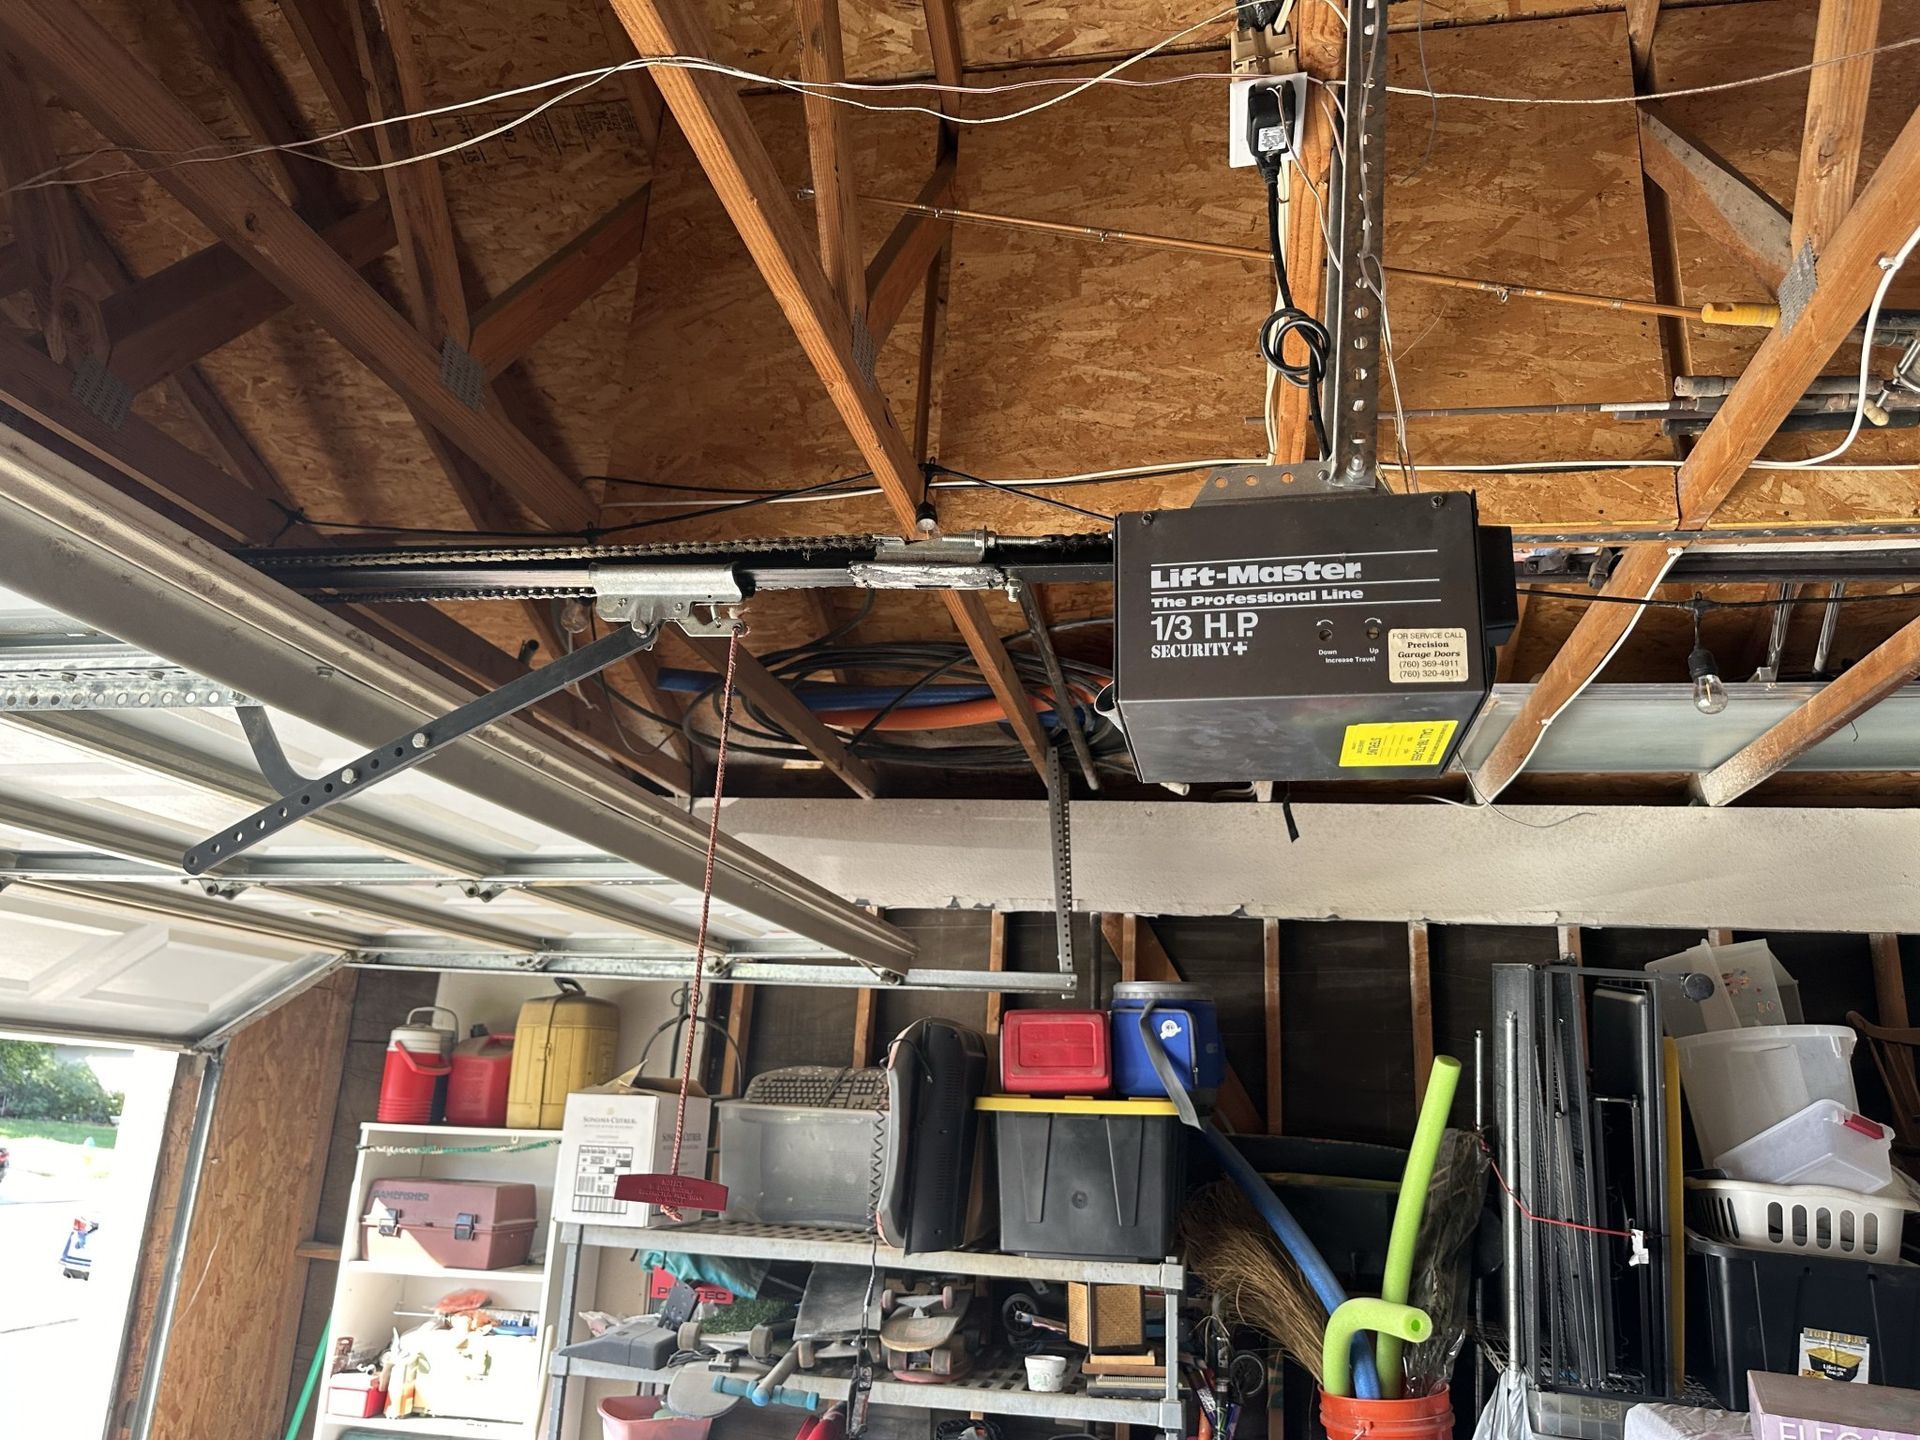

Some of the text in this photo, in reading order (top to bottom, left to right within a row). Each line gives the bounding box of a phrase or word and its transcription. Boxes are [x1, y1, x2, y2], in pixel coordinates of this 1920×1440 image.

[1151, 561, 1362, 588] Lift-Master
[1151, 588, 1364, 608] The Professional Line
[1150, 611, 1259, 641] 1/3 H.P.
[1392, 632, 1409, 640] FOR
[1444, 631, 1464, 639] CALL
[1407, 641, 1449, 649] Precision
[1397, 650, 1460, 659] Garage Doors
[1325, 655, 1376, 664] Increase Travel
[1399, 660, 1459, 669] (760) 369-4911
[1399, 669, 1459, 679] (760) 320-4911
